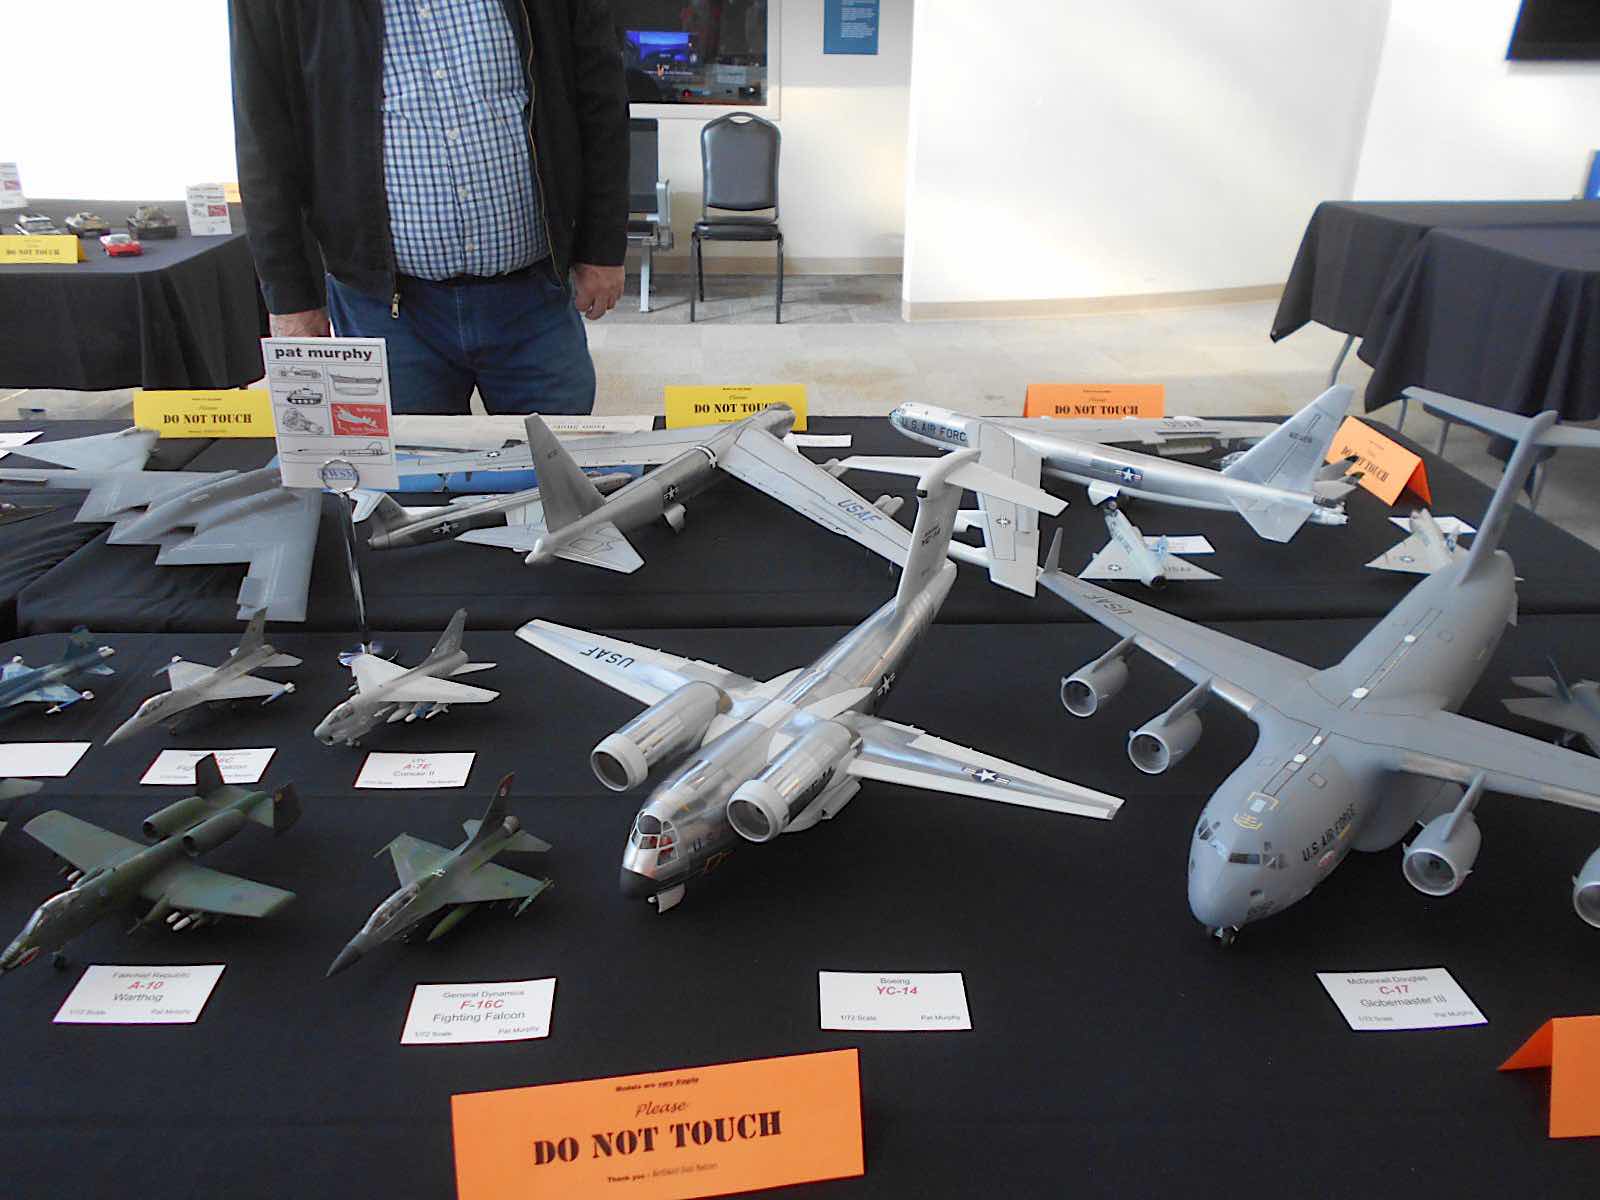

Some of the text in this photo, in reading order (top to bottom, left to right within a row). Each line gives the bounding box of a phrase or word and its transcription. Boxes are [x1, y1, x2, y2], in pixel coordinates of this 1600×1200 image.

[275, 347, 372, 361] pat murphy
[694, 403, 768, 413] DO NOT TOU
[1055, 405, 1139, 415] DO NOT TOUCH
[163, 413, 252, 424] DO NOT TOUCH
[921, 422, 937, 434] AIR
[939, 427, 968, 442] FORC
[579, 646, 636, 669] USAF
[128, 981, 165, 990] A-10
[880, 977, 911, 985] Boeing
[442, 990, 525, 999] General Dynamics
[877, 986, 918, 995] YC-14
[1379, 984, 1409, 995] C-17
[113, 993, 164, 1002] Warthog
[1360, 994, 1448, 1007] Globemaster III
[460, 1000, 505, 1010] F-16C
[432, 1011, 526, 1024] Fighting Falcon
[635, 1100, 690, 1118] Please
[533, 1110, 783, 1165] DO NOT TOUCH
